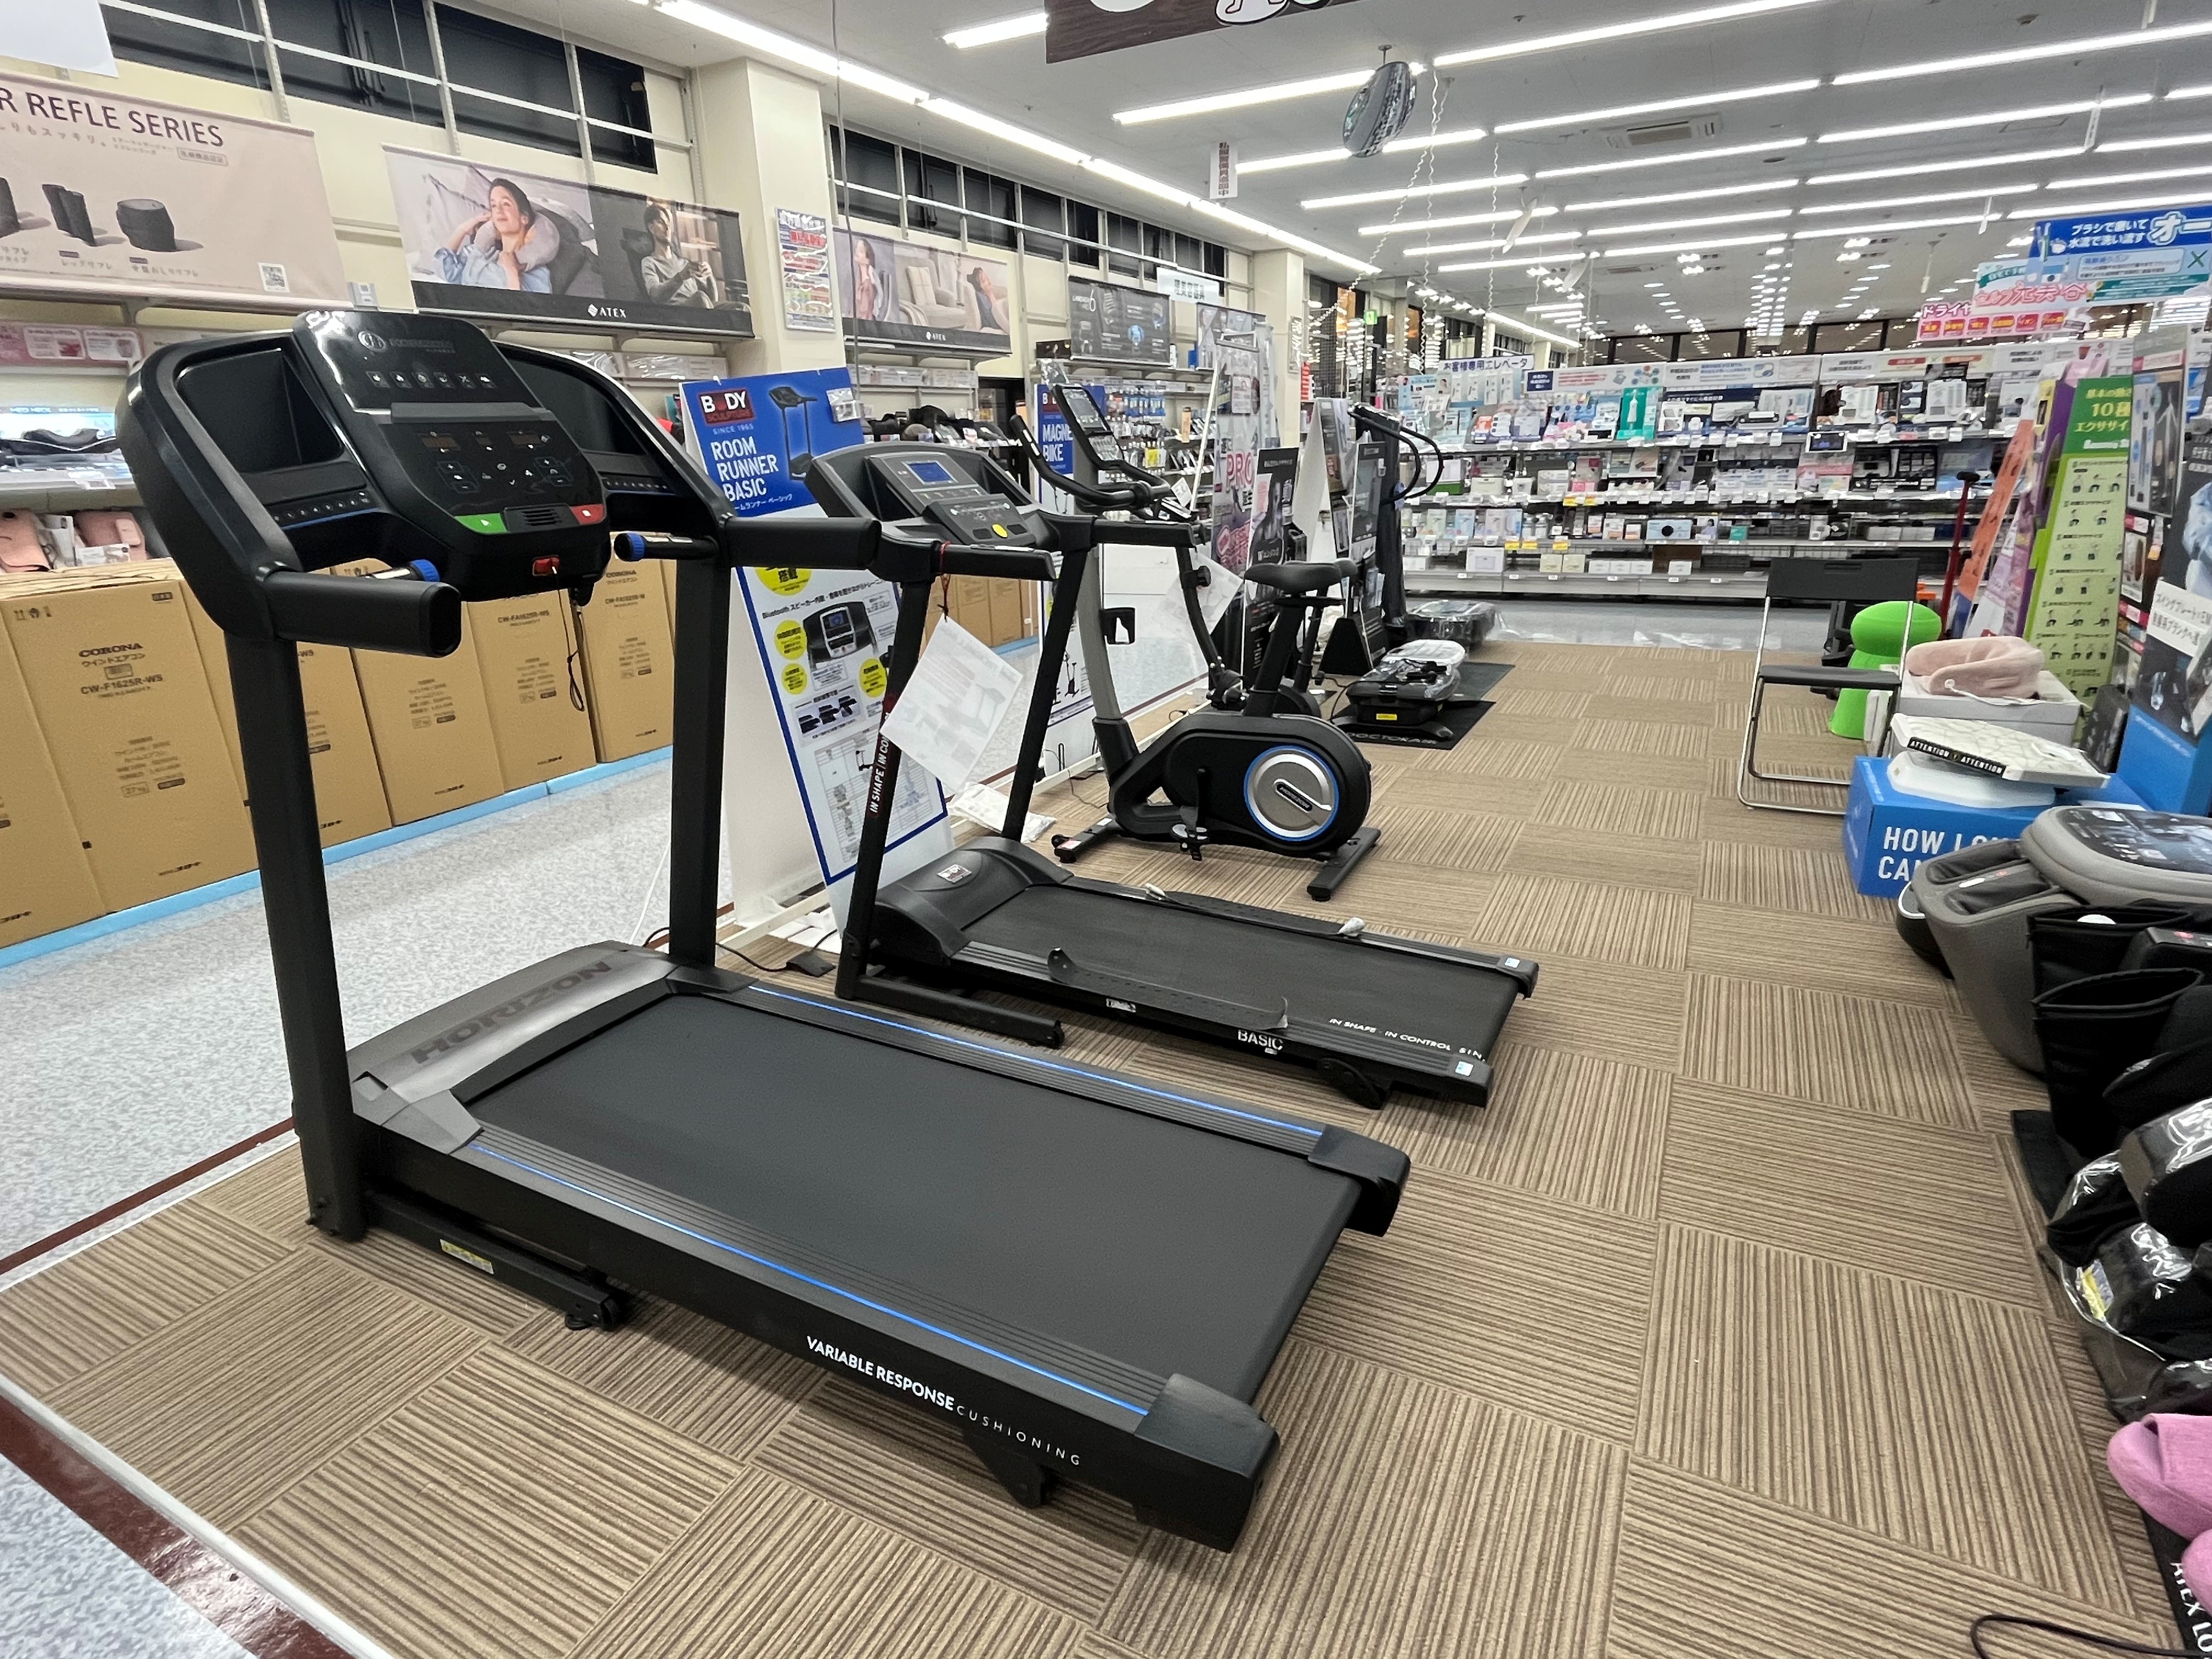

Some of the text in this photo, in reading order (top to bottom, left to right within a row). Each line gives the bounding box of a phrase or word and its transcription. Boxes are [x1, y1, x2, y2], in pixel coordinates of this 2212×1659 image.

[25, 92, 121, 130] REFLE
[128, 110, 224, 147] SERIES
[599, 307, 627, 319] ATEX
[713, 424, 754, 435] SINCE 1965
[710, 436, 757, 461] ROOM
[1043, 443, 1064, 461] BIKE
[716, 454, 779, 482] RUNNER
[722, 478, 767, 501] BASIC
[734, 500, 766, 511] ームランナー
[79, 643, 144, 657] CORONA
[878, 753, 888, 765] IN
[1910, 741, 2003, 774] ATTENTION ATTENTION
[872, 768, 885, 802] SHAPE
[870, 802, 879, 813] IN
[1883, 826, 1945, 854] HOW
[410, 961, 612, 1064] HORIZON
[1237, 1029, 1284, 1052] BASIC
[1344, 1020, 1376, 1034] SHAPE
[1385, 1030, 1398, 1040] IN
[1399, 1034, 1451, 1052] CONTROL
[1459, 1047, 1486, 1063] SIN
[806, 1335, 1080, 1466] VARIABLE RESPONSE CUSHIONING
[2192, 1622, 2212, 1658] LO
